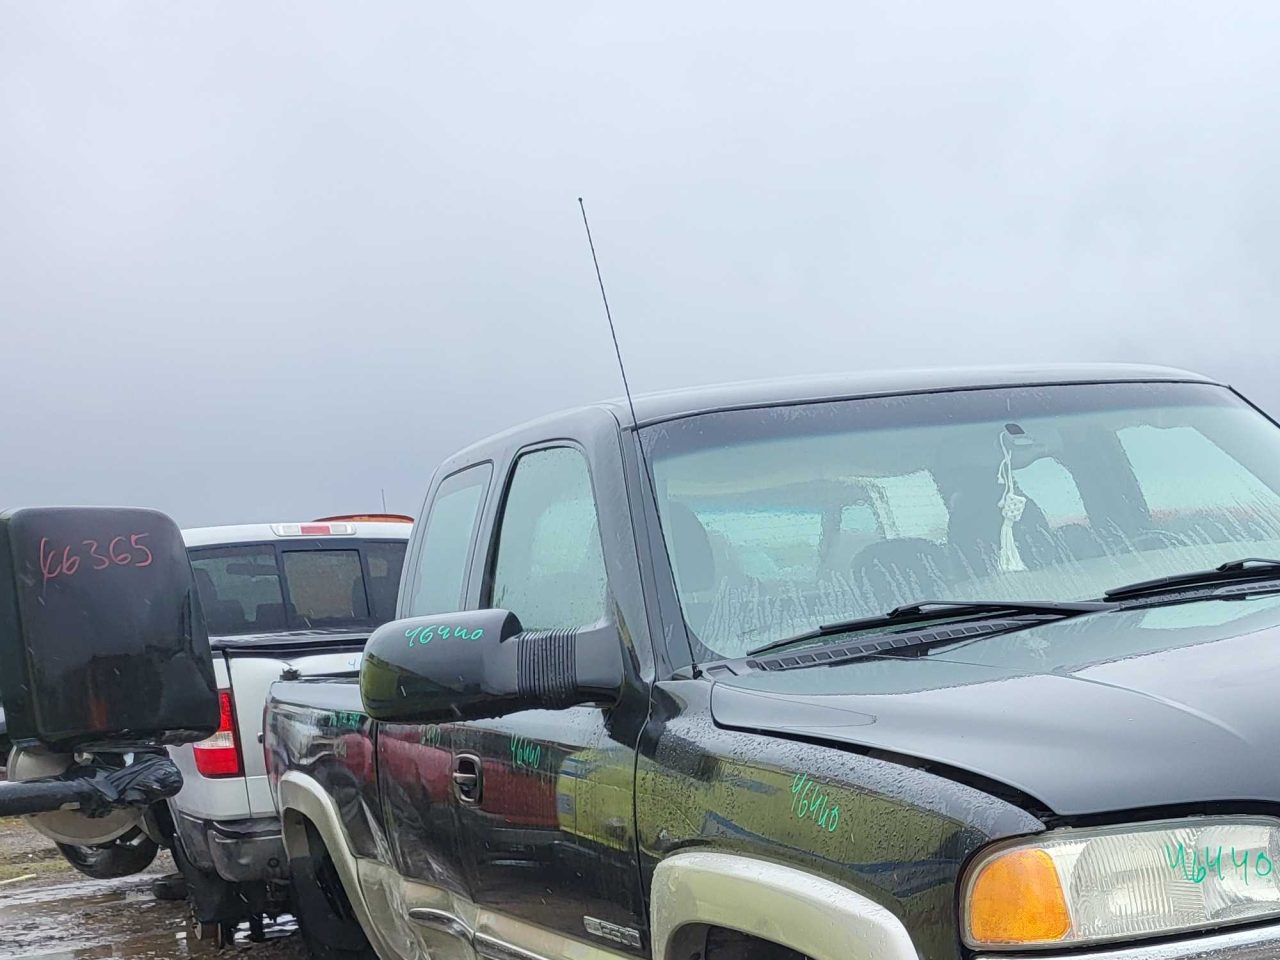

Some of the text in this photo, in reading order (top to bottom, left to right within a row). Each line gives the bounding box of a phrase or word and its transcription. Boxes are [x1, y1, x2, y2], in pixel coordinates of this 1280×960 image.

[405, 624, 484, 647] 46440
[790, 772, 839, 832] 46440
[1165, 843, 1273, 886] 46440
